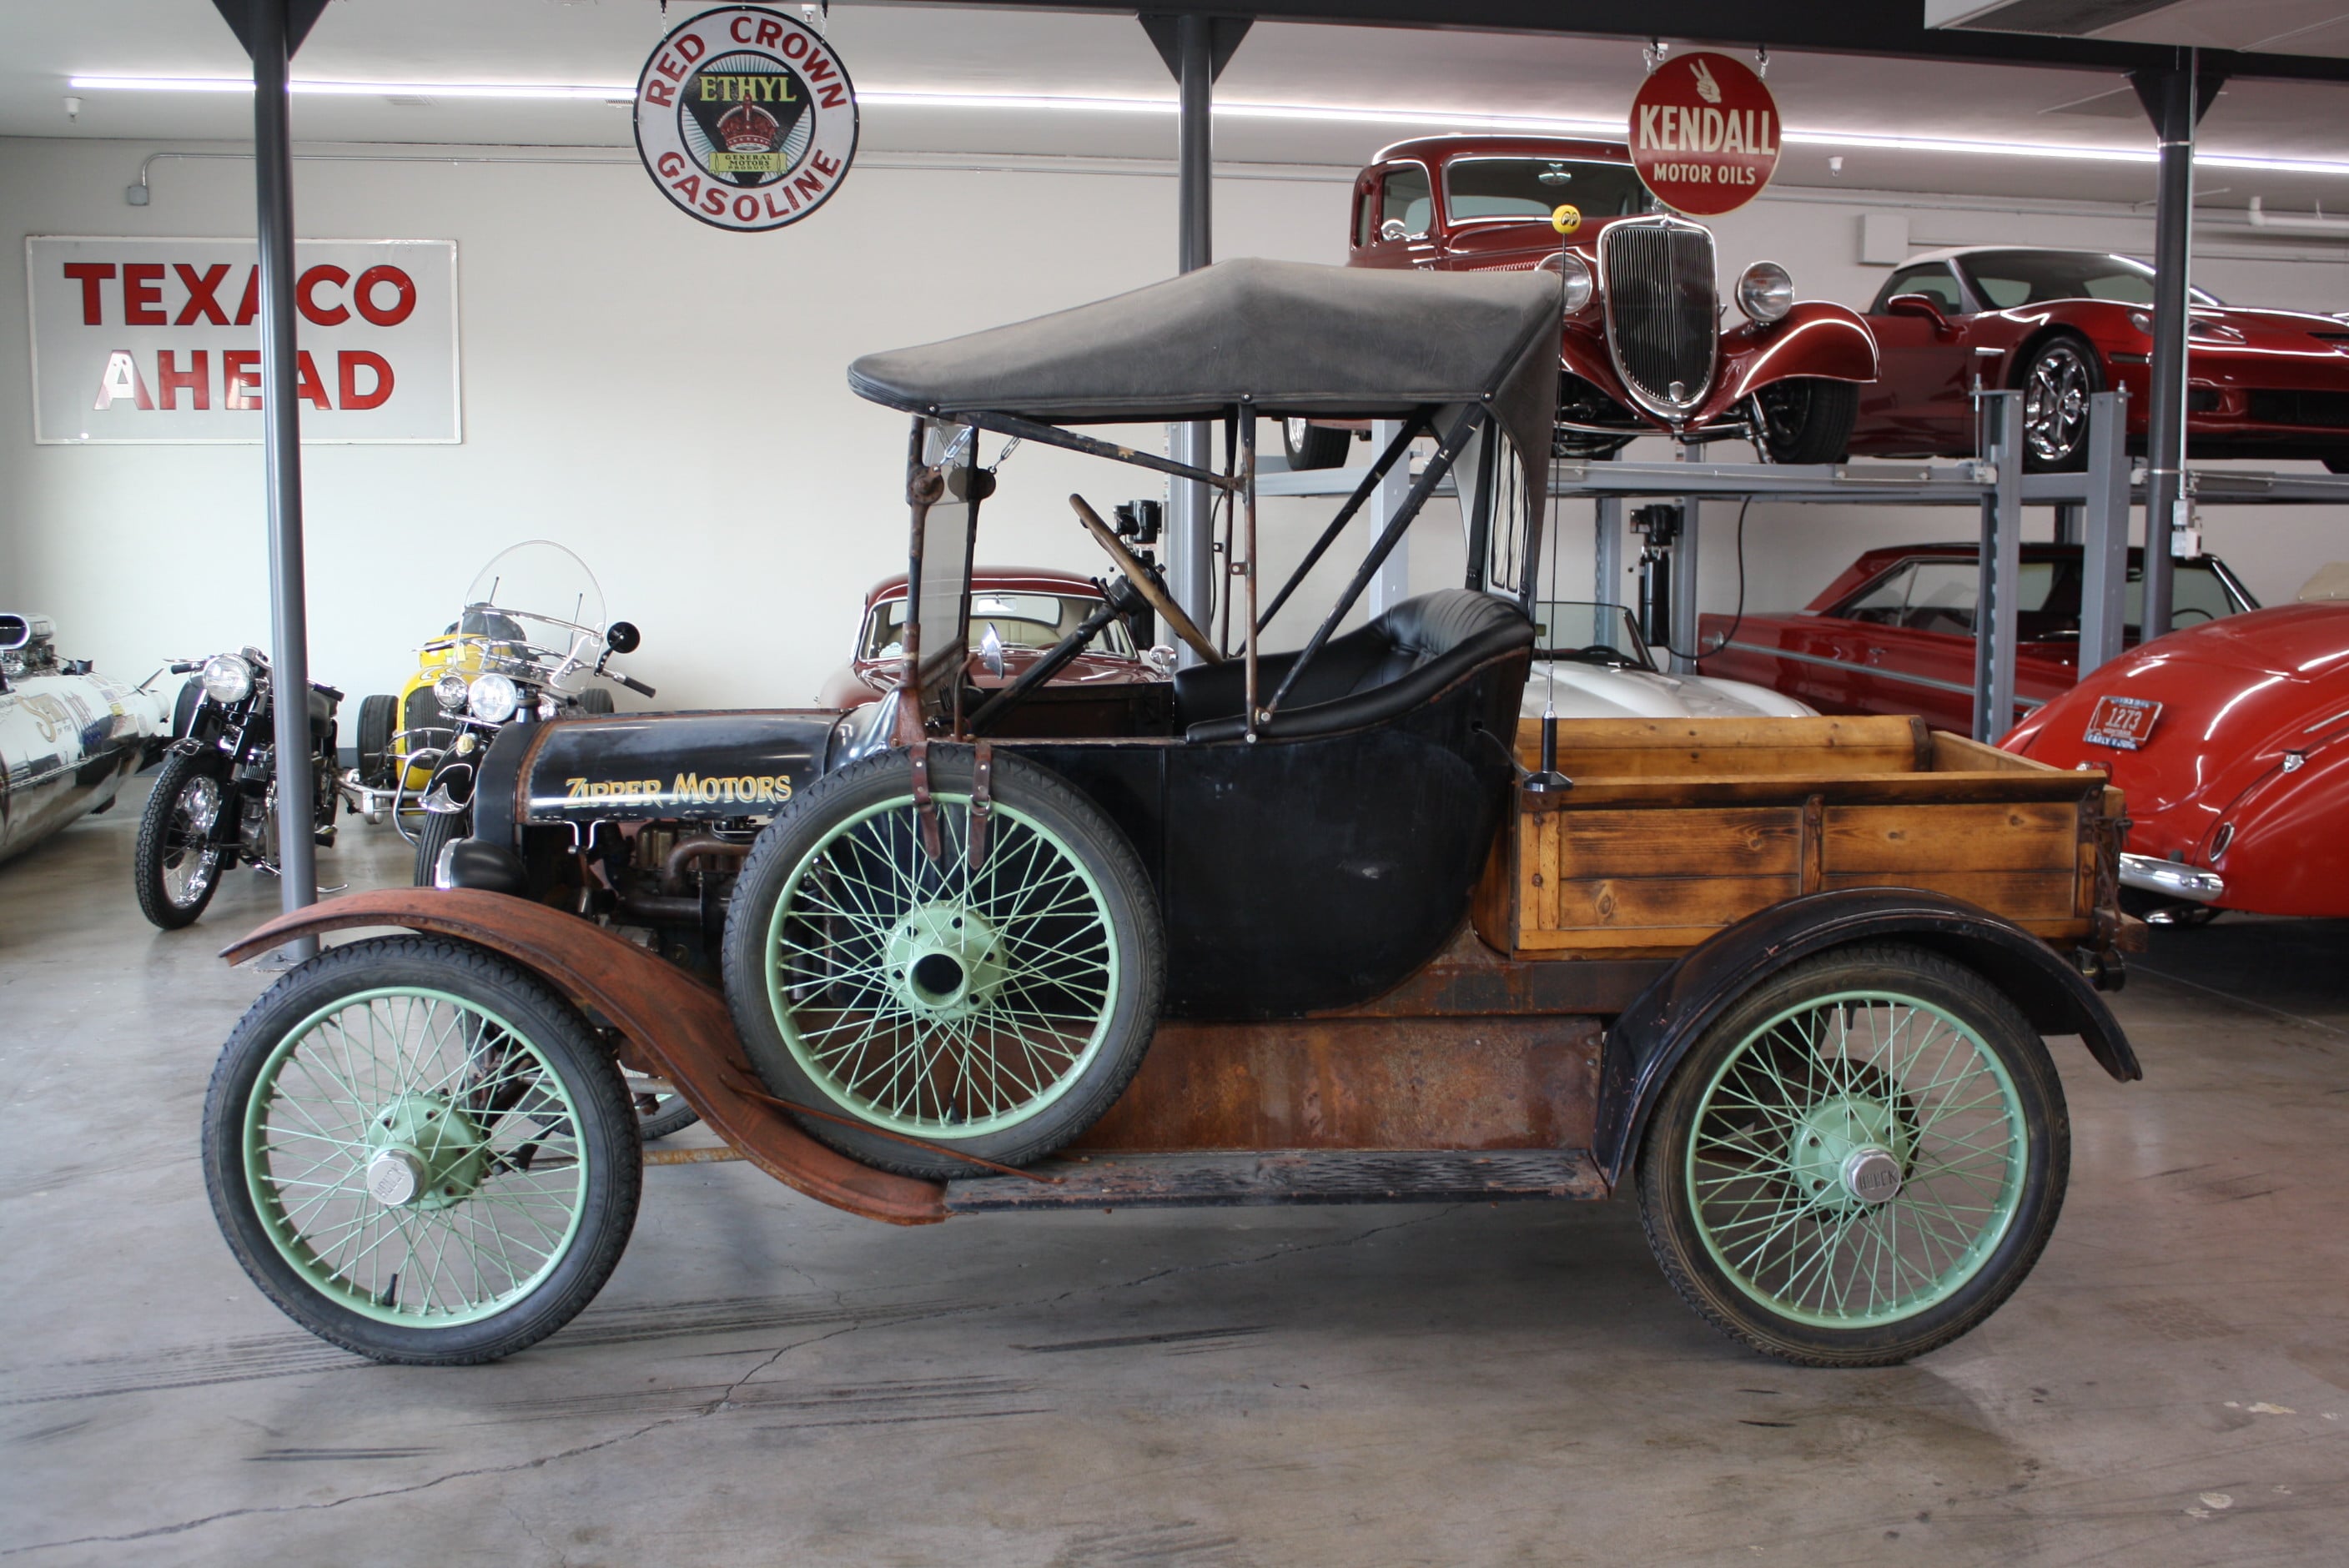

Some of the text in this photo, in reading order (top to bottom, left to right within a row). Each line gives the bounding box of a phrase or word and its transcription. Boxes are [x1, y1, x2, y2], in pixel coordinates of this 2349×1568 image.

[645, 16, 848, 109] RED CROWN
[699, 76, 797, 102] ETHYL
[1639, 104, 1775, 155] KENDALL
[657, 148, 841, 222] GASOLINE
[1653, 163, 1756, 185] MOTOR OILS
[93, 349, 395, 410] AHEAD
[2105, 707, 2142, 731] 1273
[2087, 734, 2110, 746] EARLY
[563, 772, 792, 809] ZIPPER MOTORS
